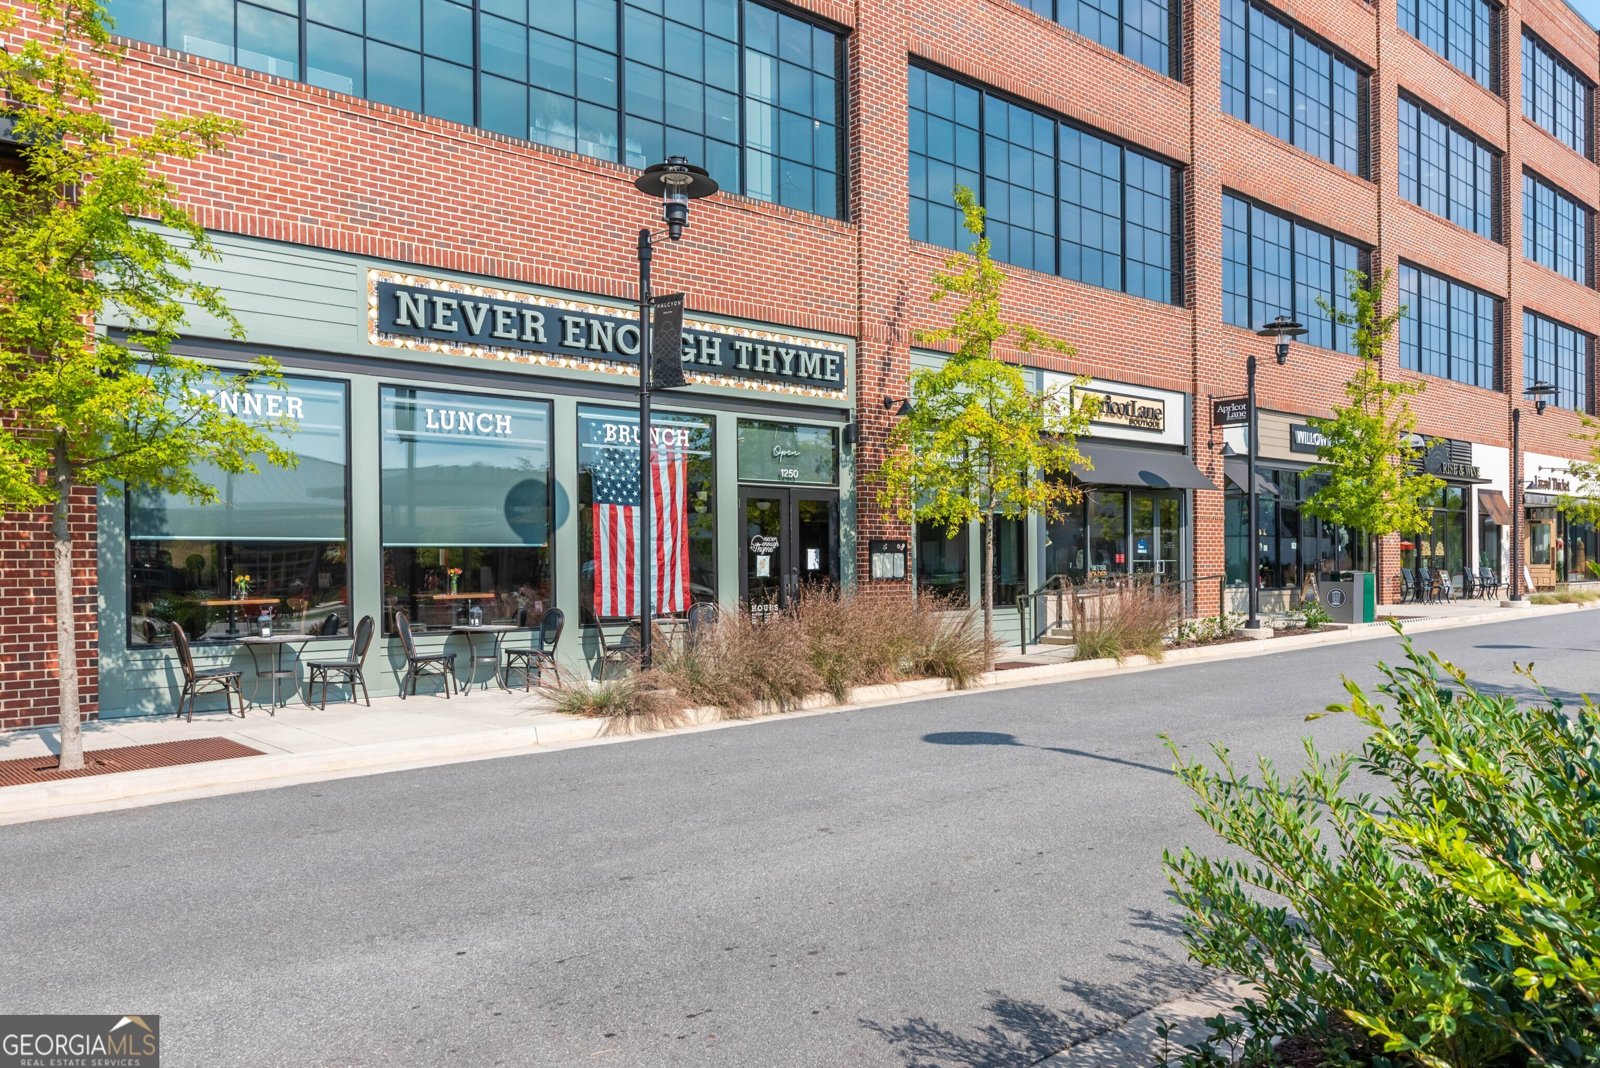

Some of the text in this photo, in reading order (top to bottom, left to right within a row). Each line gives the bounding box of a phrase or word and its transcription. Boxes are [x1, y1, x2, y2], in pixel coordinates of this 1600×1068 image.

[656, 300, 682, 309] HALCYON
[395, 290, 840, 382] NEVER ENOGH THYME
[1217, 403, 1247, 414] Apricot
[1227, 410, 1247, 419] Lane
[425, 408, 512, 435] LUNCH
[1129, 418, 1161, 428] BOUTIQUE
[773, 445, 801, 463] Open
[781, 468, 799, 479] 1250
